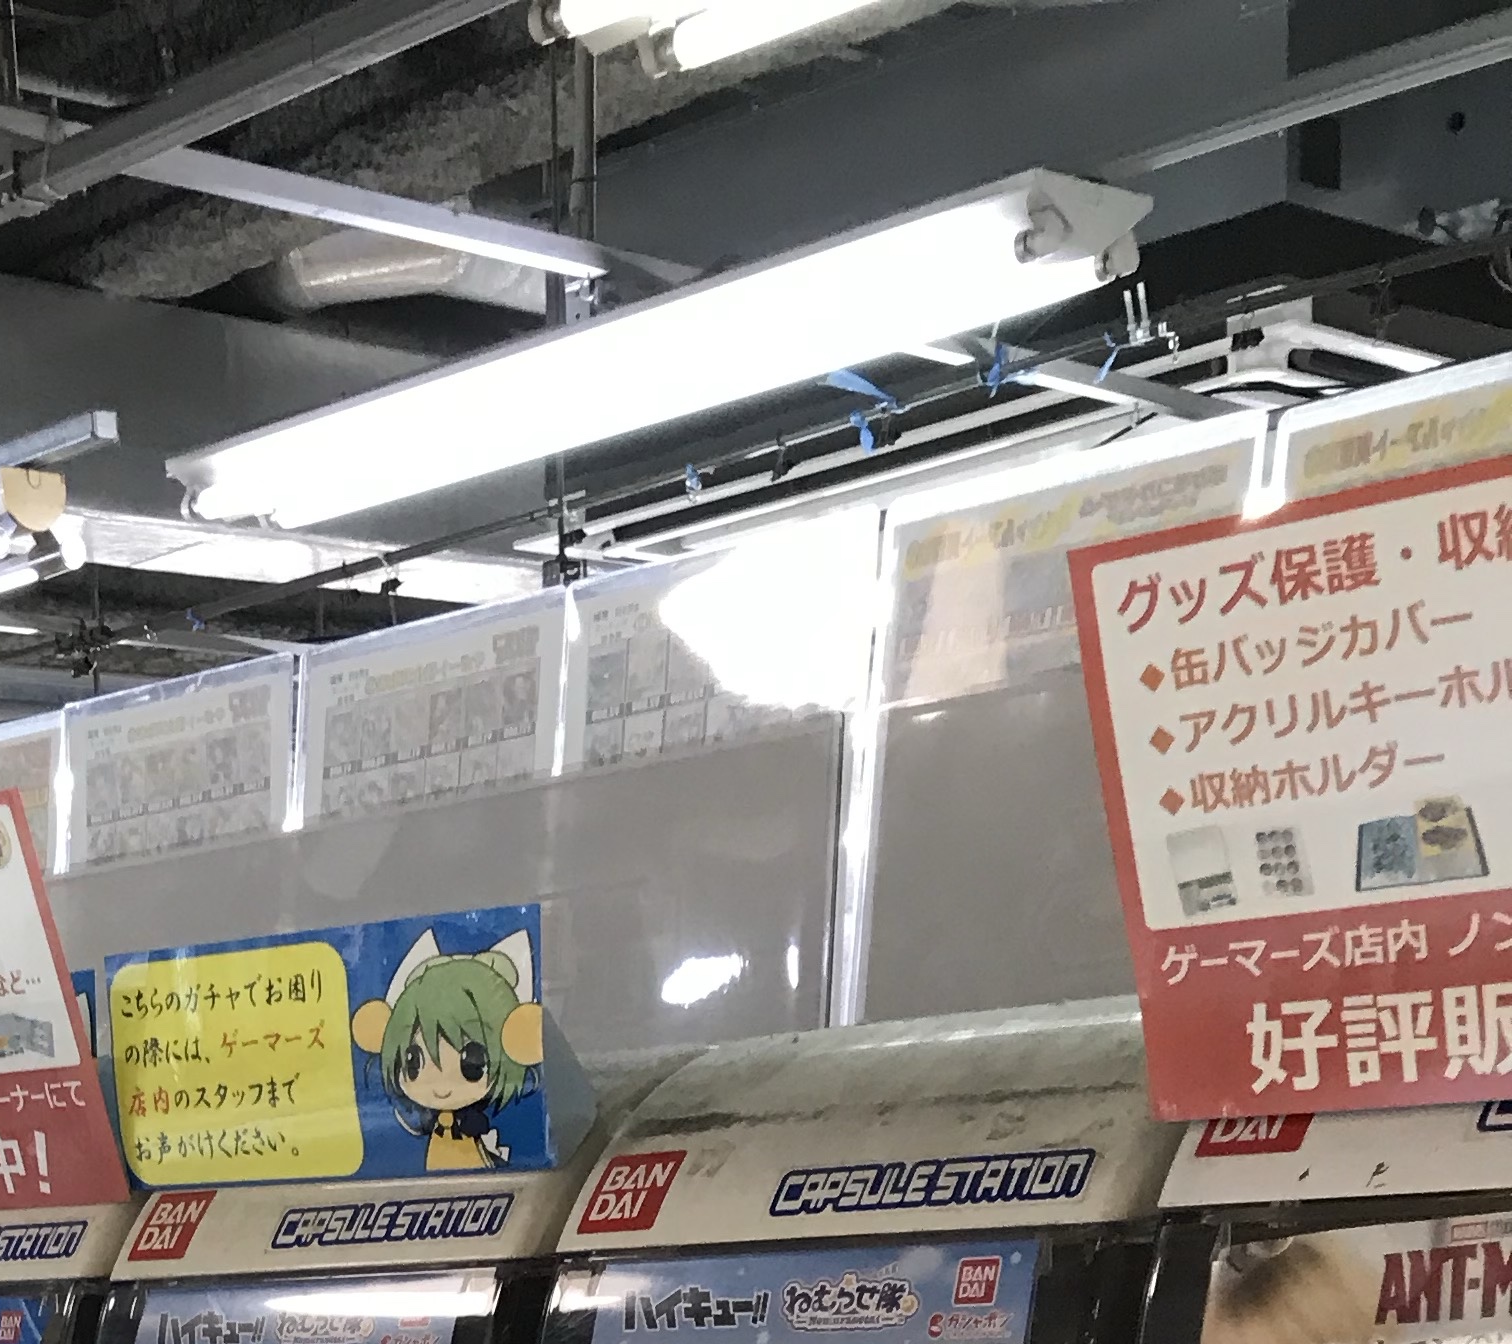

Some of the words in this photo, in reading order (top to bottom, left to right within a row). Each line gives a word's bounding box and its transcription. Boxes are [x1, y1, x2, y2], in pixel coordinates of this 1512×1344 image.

[1170, 601, 1474, 689] 缶バッジカバー
[1188, 741, 1446, 814] 収納ホルダー
[1160, 918, 1430, 986] ゲーマーズ店内
[120, 967, 323, 1020] こちらのガチャでお困り
[128, 1072, 301, 1118] 店内のスタッフまで
[134, 1126, 301, 1163] お声がけください。
[602, 1160, 672, 1190] BAN
[152, 1198, 205, 1223] BAN
[589, 1195, 649, 1222] DAI
[138, 1225, 183, 1250] DAI
[961, 1265, 995, 1282] BAN
[958, 1282, 987, 1299] DAI
